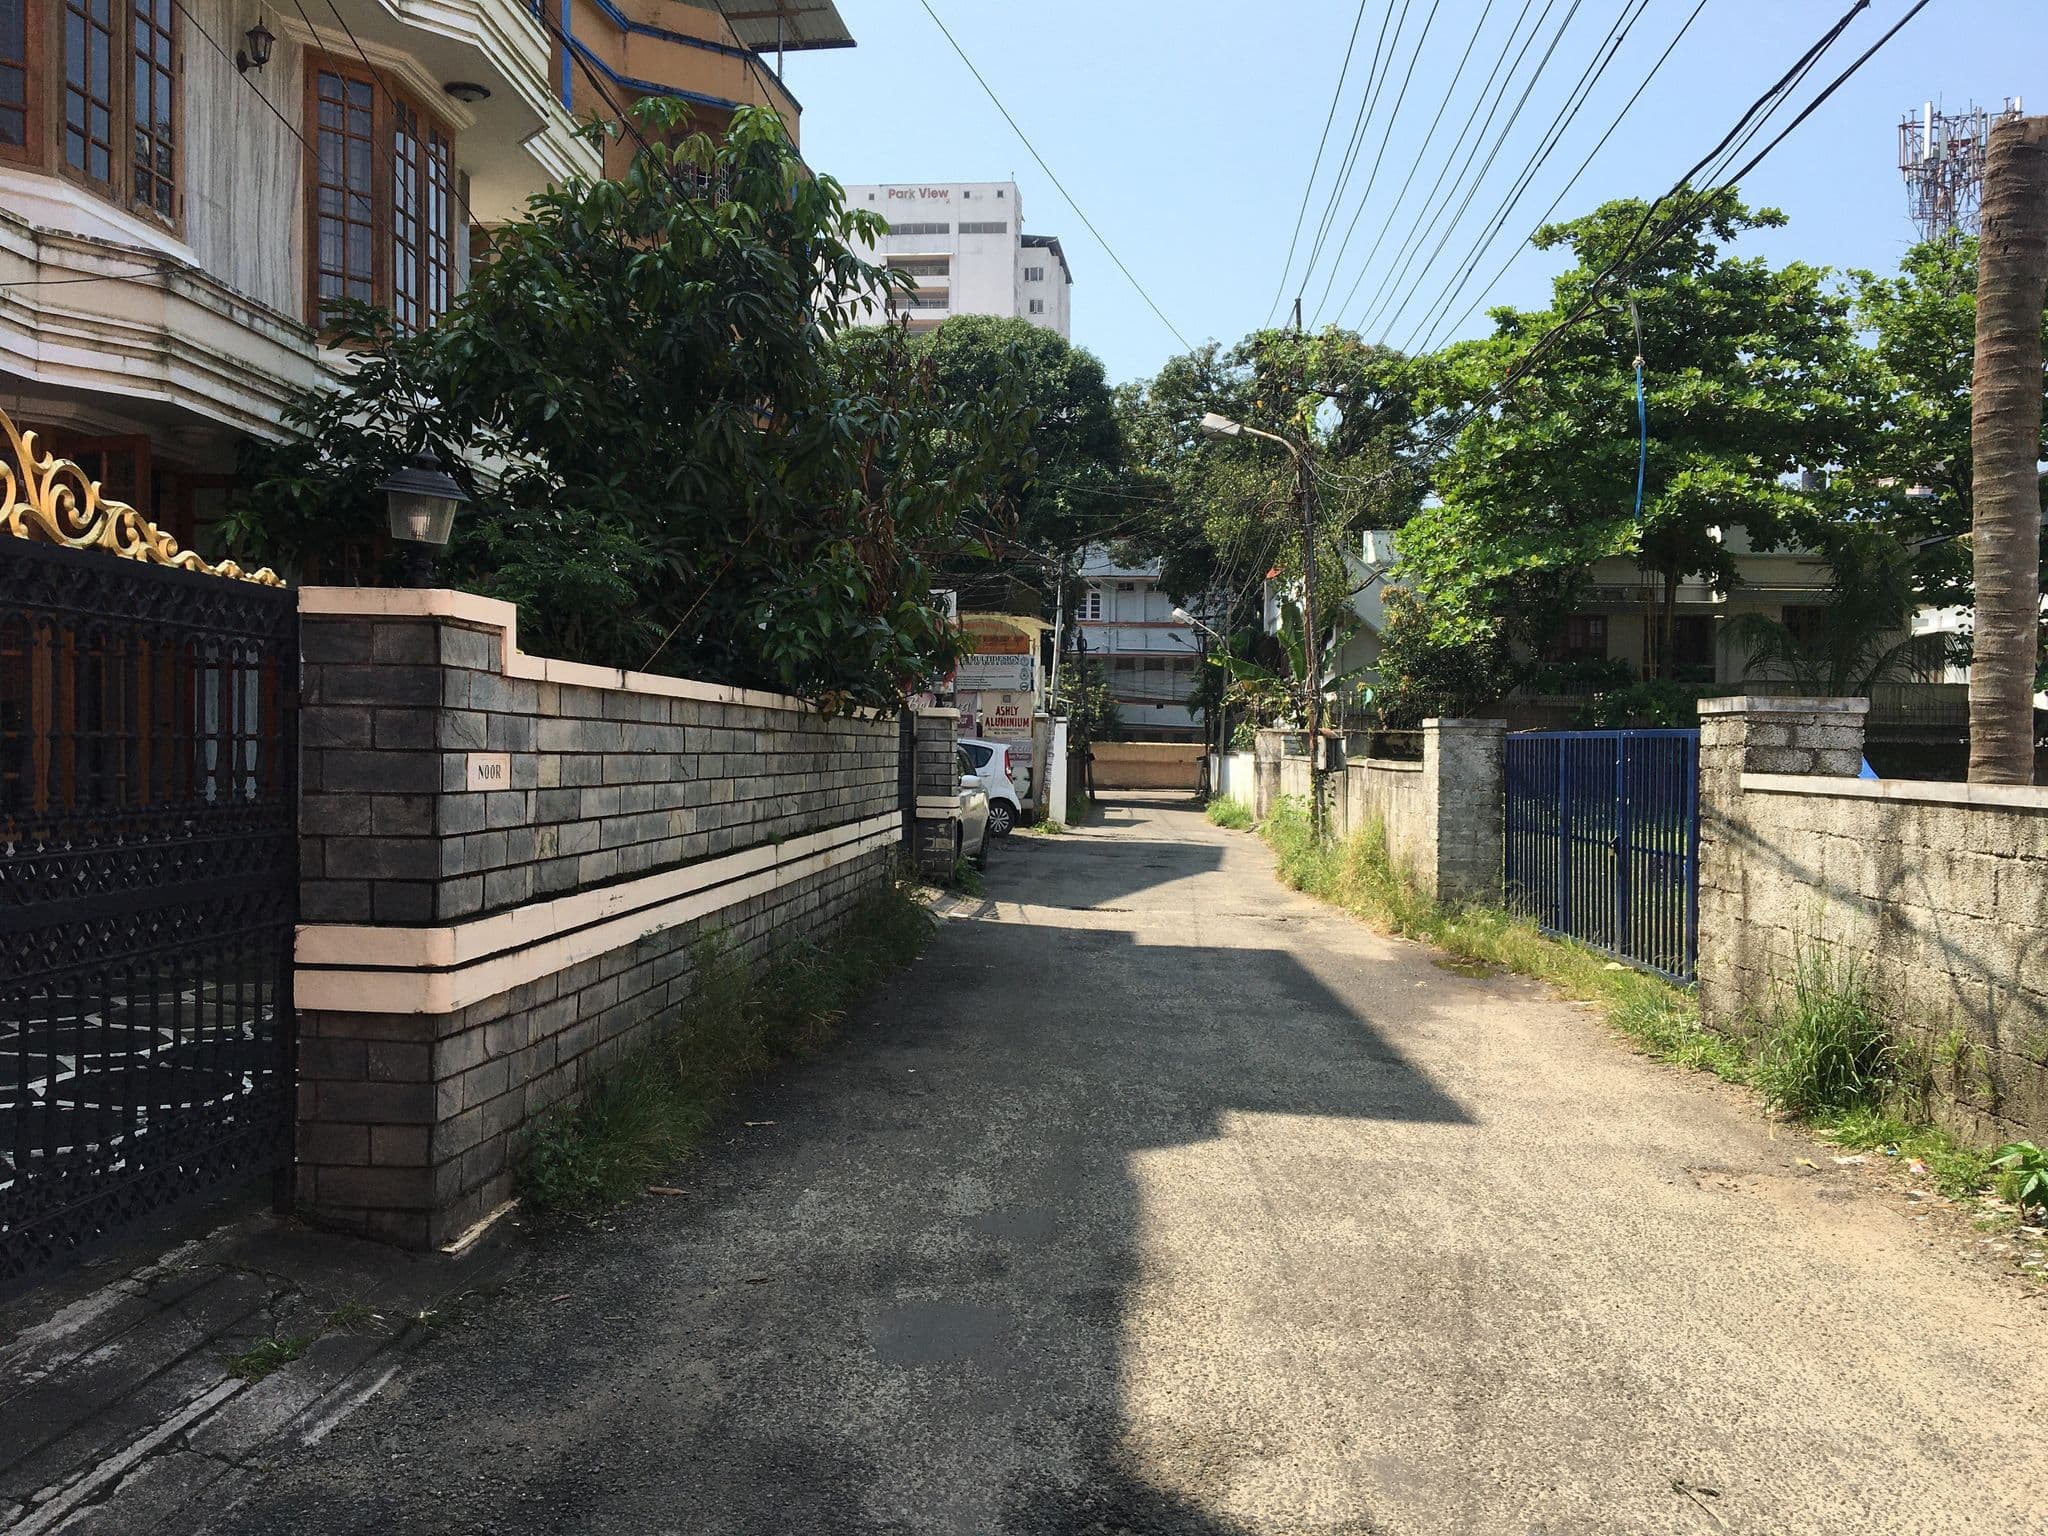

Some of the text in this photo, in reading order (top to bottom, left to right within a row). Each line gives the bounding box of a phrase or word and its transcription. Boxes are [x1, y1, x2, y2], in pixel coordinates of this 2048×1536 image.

[888, 188, 949, 199] Park View
[996, 706, 1019, 716] ASHLY
[985, 717, 1030, 727] ALUMINIUM
[479, 765, 501, 780] NOOR
